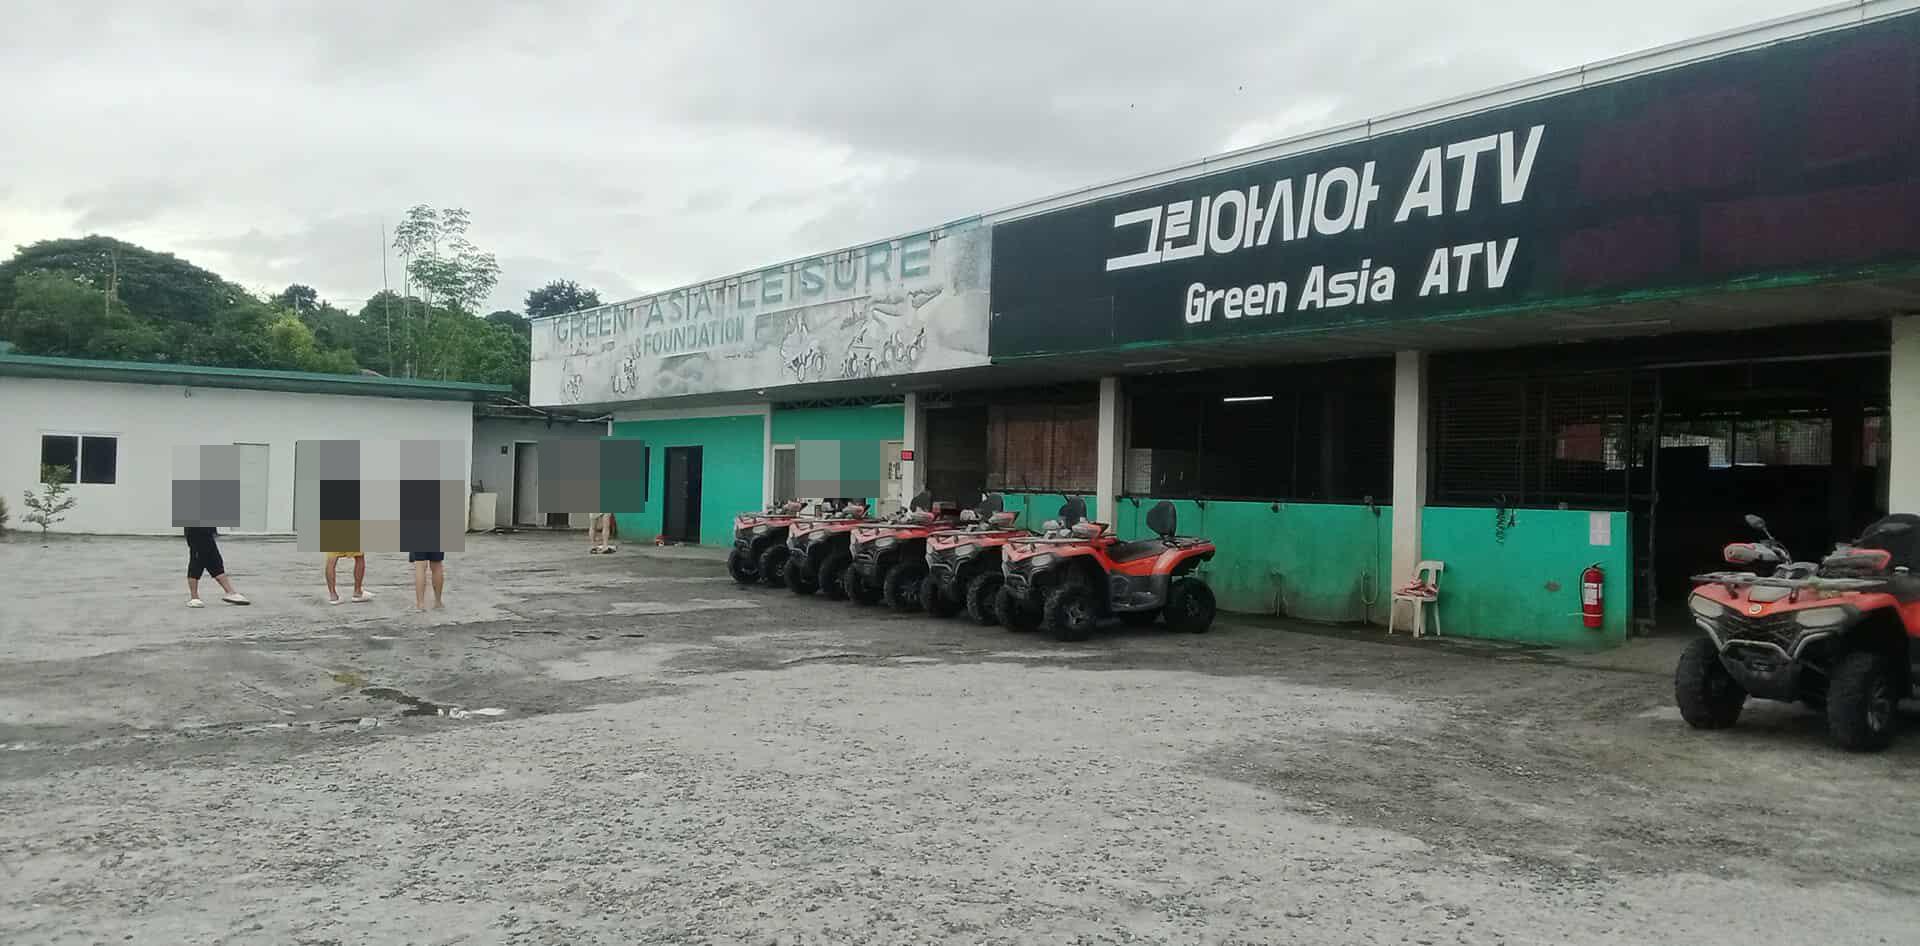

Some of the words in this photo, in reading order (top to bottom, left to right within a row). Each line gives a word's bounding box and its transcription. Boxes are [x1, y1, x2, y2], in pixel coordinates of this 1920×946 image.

[1106, 161, 1379, 272] 그린아시아
[1394, 124, 1545, 223] ATV
[738, 231, 931, 310] LEISURE
[1184, 281, 1287, 324] Green
[1297, 258, 1396, 310] Asia
[1419, 237, 1520, 297] ATV
[644, 314, 746, 357] FOUNDATION
